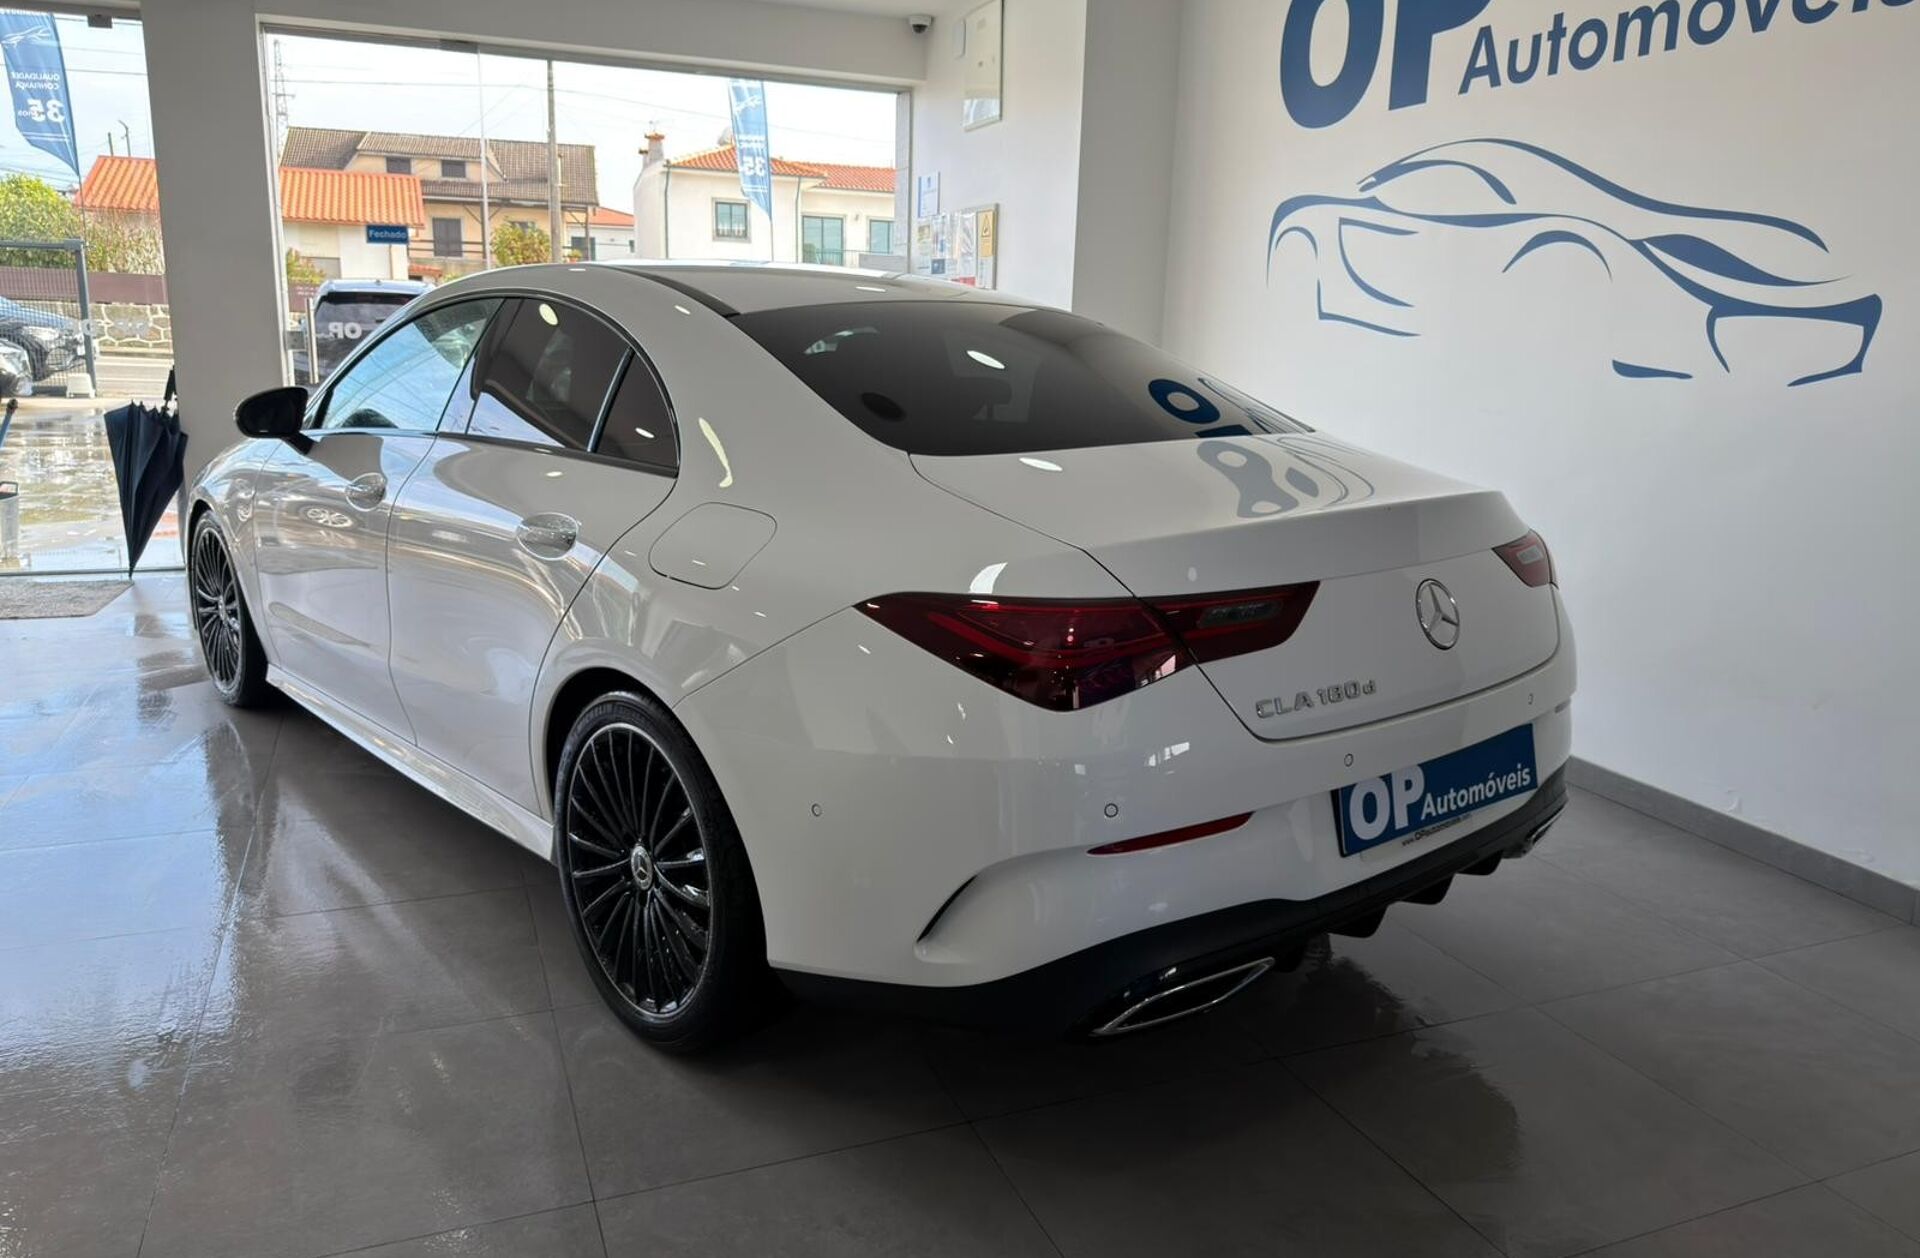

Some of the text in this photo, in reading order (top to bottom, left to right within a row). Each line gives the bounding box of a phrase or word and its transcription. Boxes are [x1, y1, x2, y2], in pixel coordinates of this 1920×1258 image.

[369, 229, 406, 239] Fechado
[1255, 691, 1314, 719] CLA
[1349, 765, 1425, 841] OP
[1421, 763, 1531, 820] Automóveis
